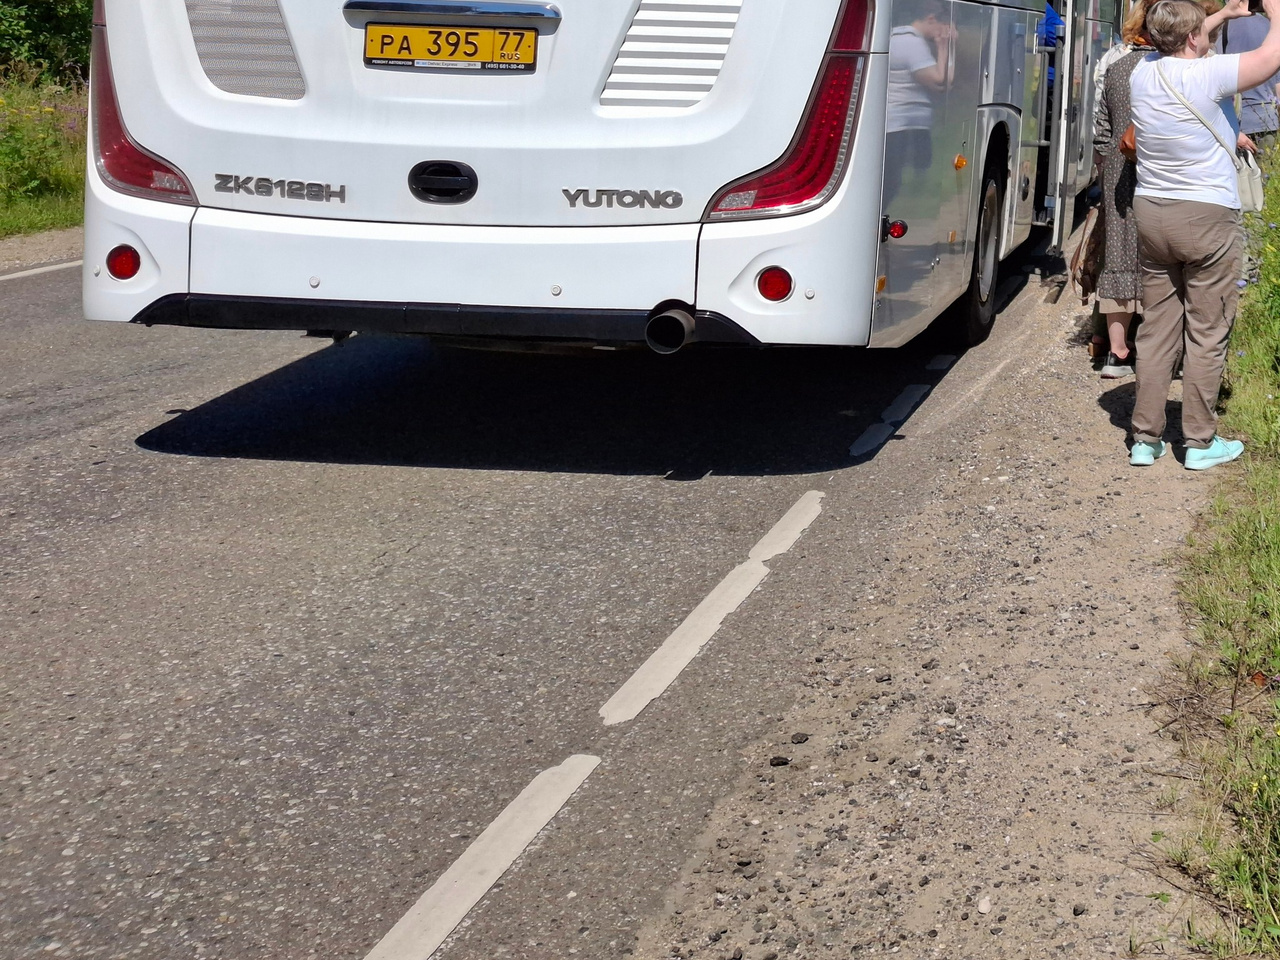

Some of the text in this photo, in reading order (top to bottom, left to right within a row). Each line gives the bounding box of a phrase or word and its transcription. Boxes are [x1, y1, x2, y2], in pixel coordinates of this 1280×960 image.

[426, 30, 480, 57] 395
[498, 31, 525, 52] 77
[500, 52, 520, 61] RUS
[561, 189, 683, 209] YUTONG
